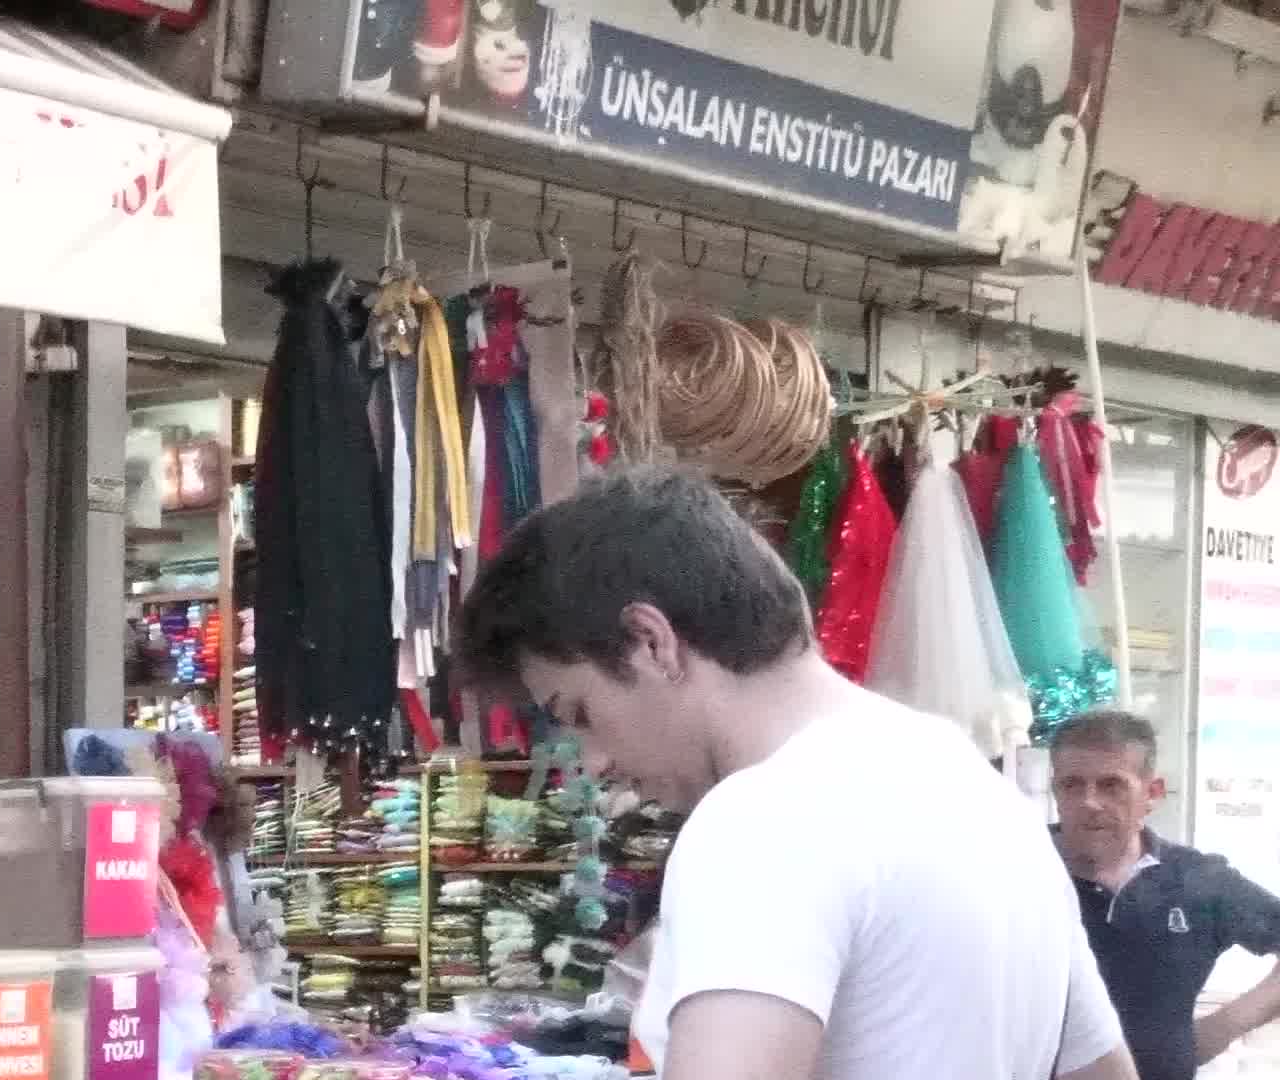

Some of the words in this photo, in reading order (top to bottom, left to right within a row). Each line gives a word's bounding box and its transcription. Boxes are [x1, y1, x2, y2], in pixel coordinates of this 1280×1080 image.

[750, 107, 865, 178] ENSTİTÜ
[867, 139, 957, 202] PAZARI
[107, 1013, 141, 1040] SÜT
[101, 1039, 145, 1064] TOZU
